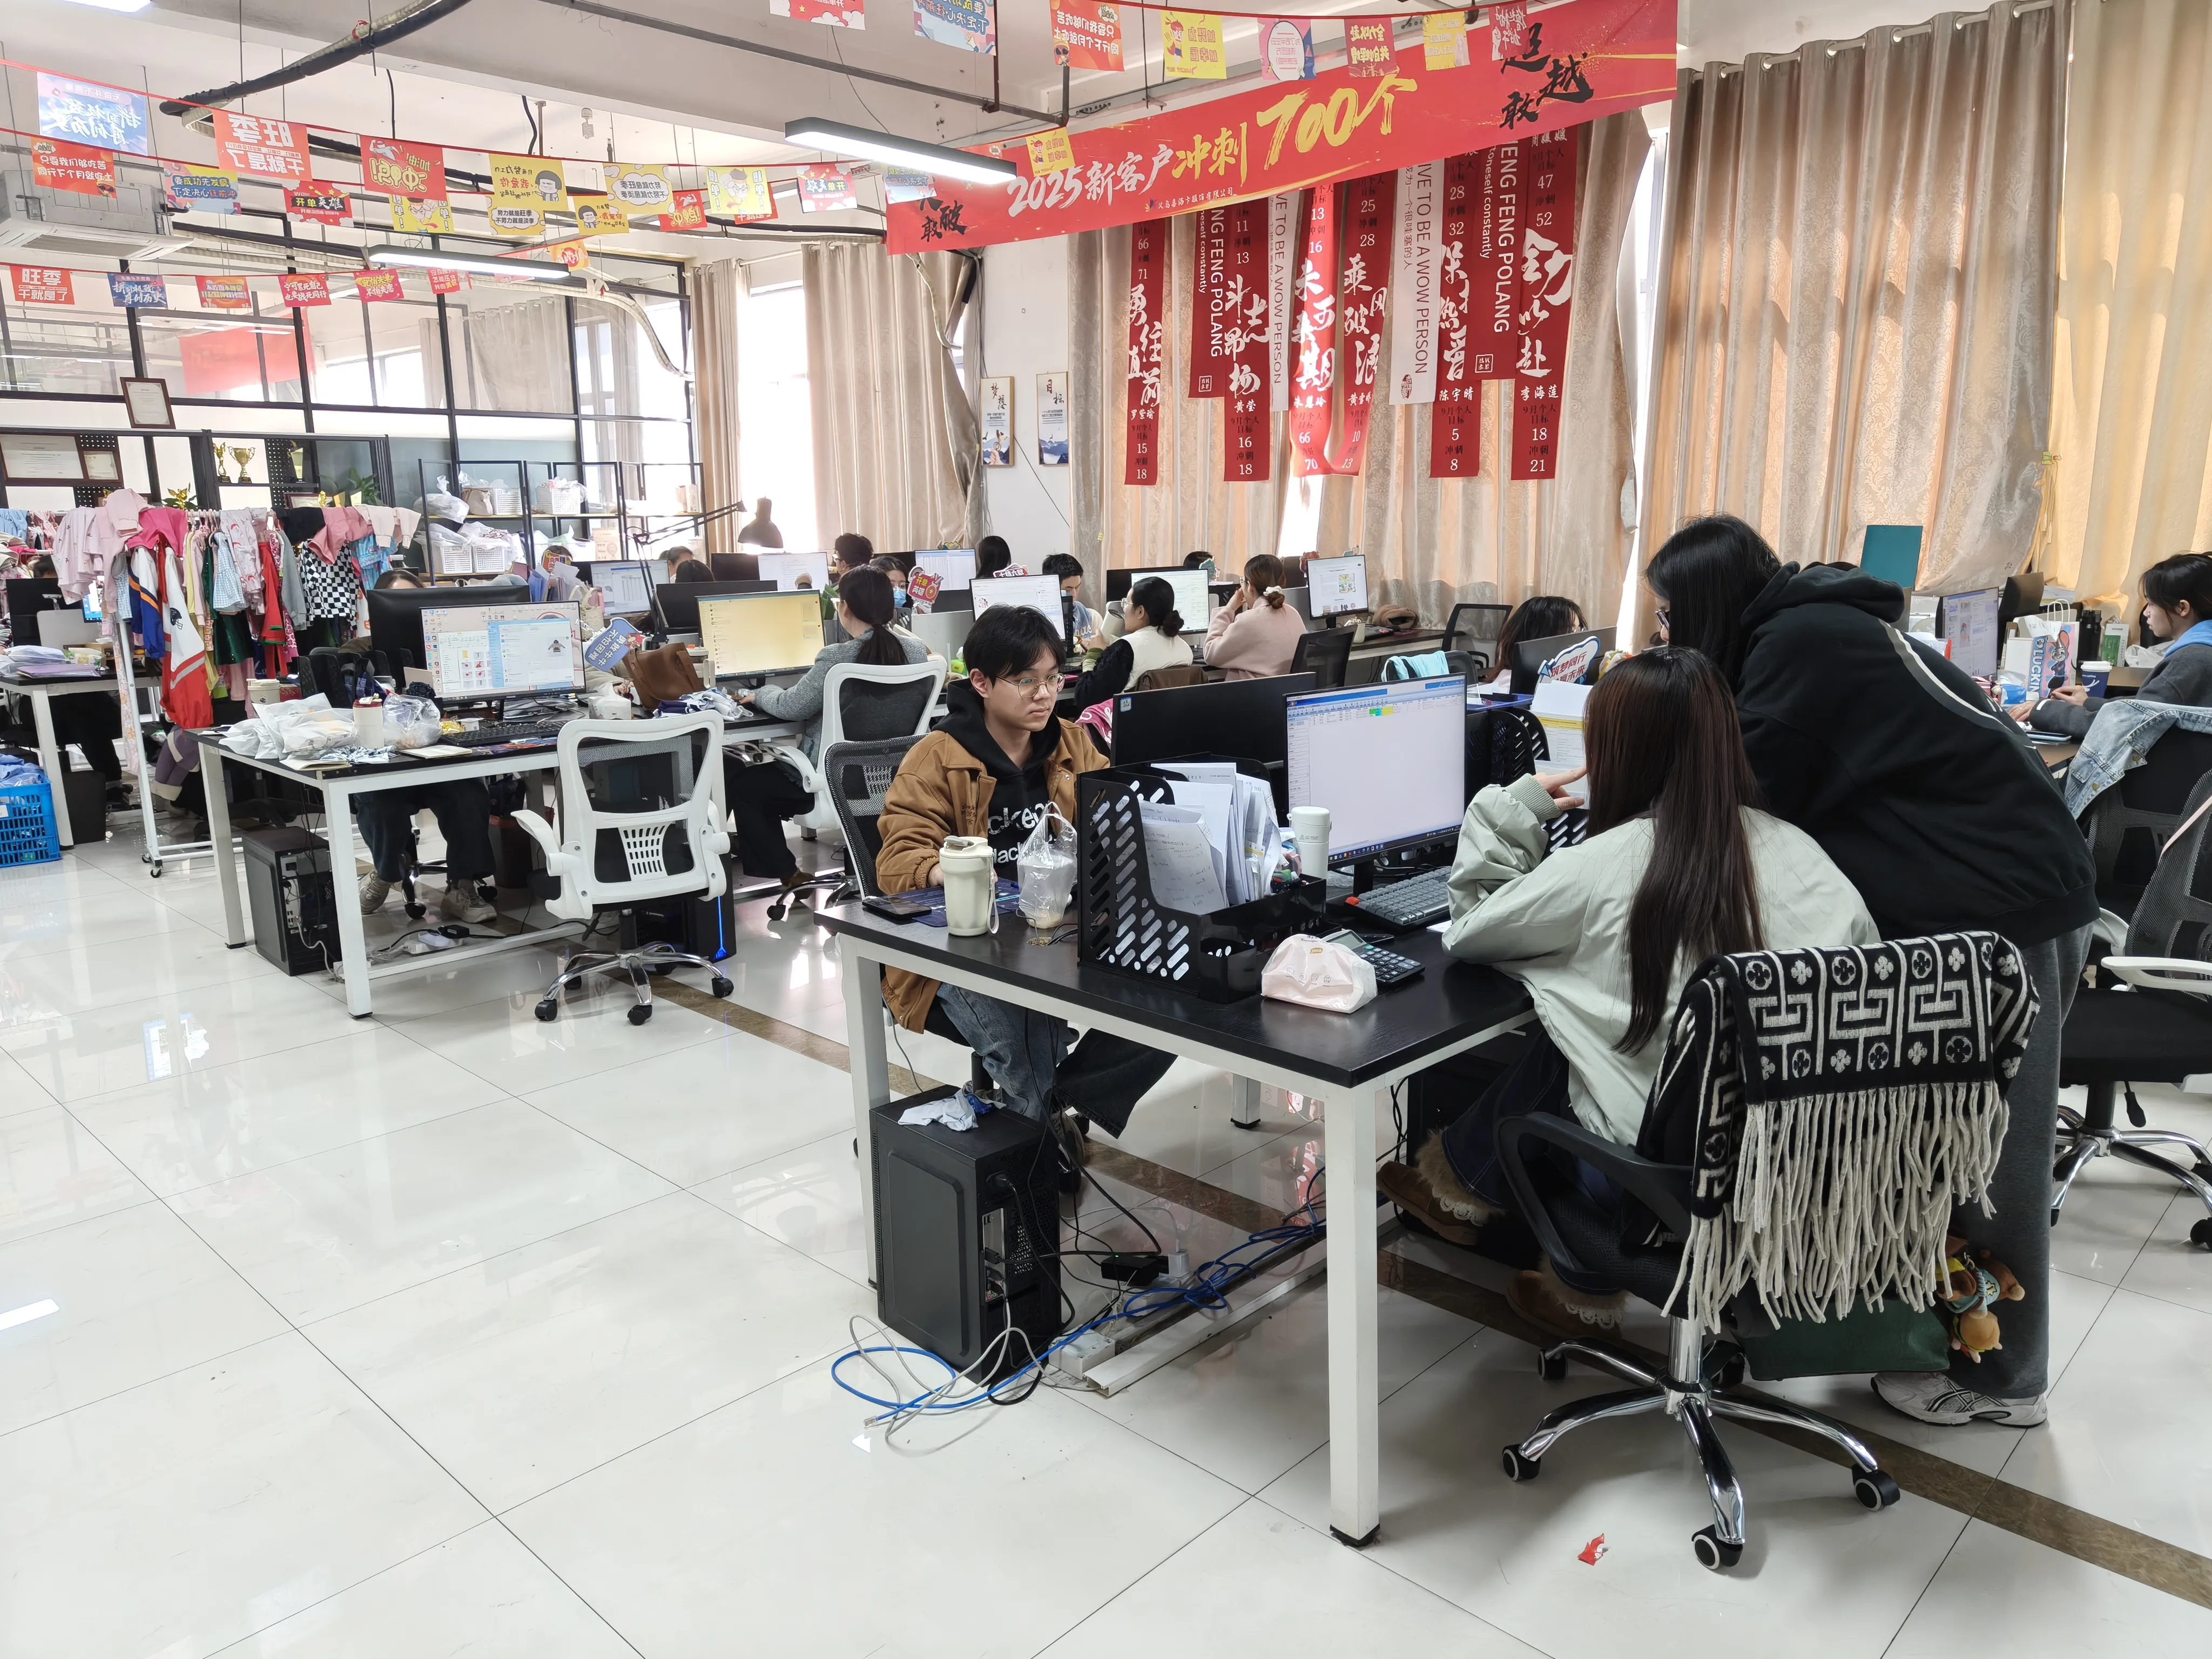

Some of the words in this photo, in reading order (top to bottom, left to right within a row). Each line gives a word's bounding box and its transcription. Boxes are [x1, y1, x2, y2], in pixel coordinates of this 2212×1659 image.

[1500, 92, 1538, 130] 敢
[40, 154, 107, 170] 只要我们够吃苦
[37, 166, 114, 182] 同行下个月就吃土
[174, 176, 230, 187] 要成功先发疯
[1537, 174, 1554, 189] 47
[1450, 186, 1465, 200] 28
[296, 195, 345, 211] 开单英雄
[1361, 199, 1375, 213] 25
[1417, 192, 1431, 216] TO
[1311, 207, 1325, 220] 13
[1498, 194, 1515, 245] FENG
[1536, 212, 1552, 227] 52
[921, 215, 943, 242] 敢
[1236, 220, 1249, 233] 11
[1276, 214, 1286, 236] TO
[1417, 220, 1431, 242] BE
[1449, 221, 1464, 236] 32
[1479, 197, 1492, 259] constantly
[1138, 238, 1149, 250] 66
[1309, 240, 1323, 254] 16
[1360, 233, 1375, 247] 28
[1236, 251, 1249, 264] 13
[1275, 241, 1285, 260] BE
[1416, 246, 1429, 259] A
[1198, 241, 1206, 294] constantly
[1211, 239, 1224, 284] FENG
[1138, 268, 1148, 280] 71
[1274, 264, 1284, 274] A
[22, 267, 62, 286] 旺季
[1415, 260, 1429, 304] WOW
[18, 289, 68, 301] 干就是了
[1274, 276, 1284, 319] WOW
[1493, 252, 1514, 334] POLANG
[1210, 288, 1224, 358] POLANG
[1414, 308, 1429, 374] PERSON
[1273, 323, 1283, 384] PERSON
[1234, 399, 1256, 414] 黄莹
[1299, 431, 1311, 444] 66
[1352, 430, 1361, 442] 10
[1451, 428, 1459, 441] 5
[1532, 427, 1547, 441] 18
[1137, 443, 1148, 454] 15
[1238, 436, 1252, 448] 16
[1239, 463, 1253, 475] 18
[1304, 458, 1319, 471] 70
[1341, 457, 1353, 469] 13
[1450, 458, 1458, 471] 8
[1530, 459, 1545, 472] 21
[1137, 468, 1147, 480] 18
[916, 576, 929, 587] 开单
[588, 629, 619, 660] 不怕困难
[598, 634, 627, 666] 勇敢牛牛
